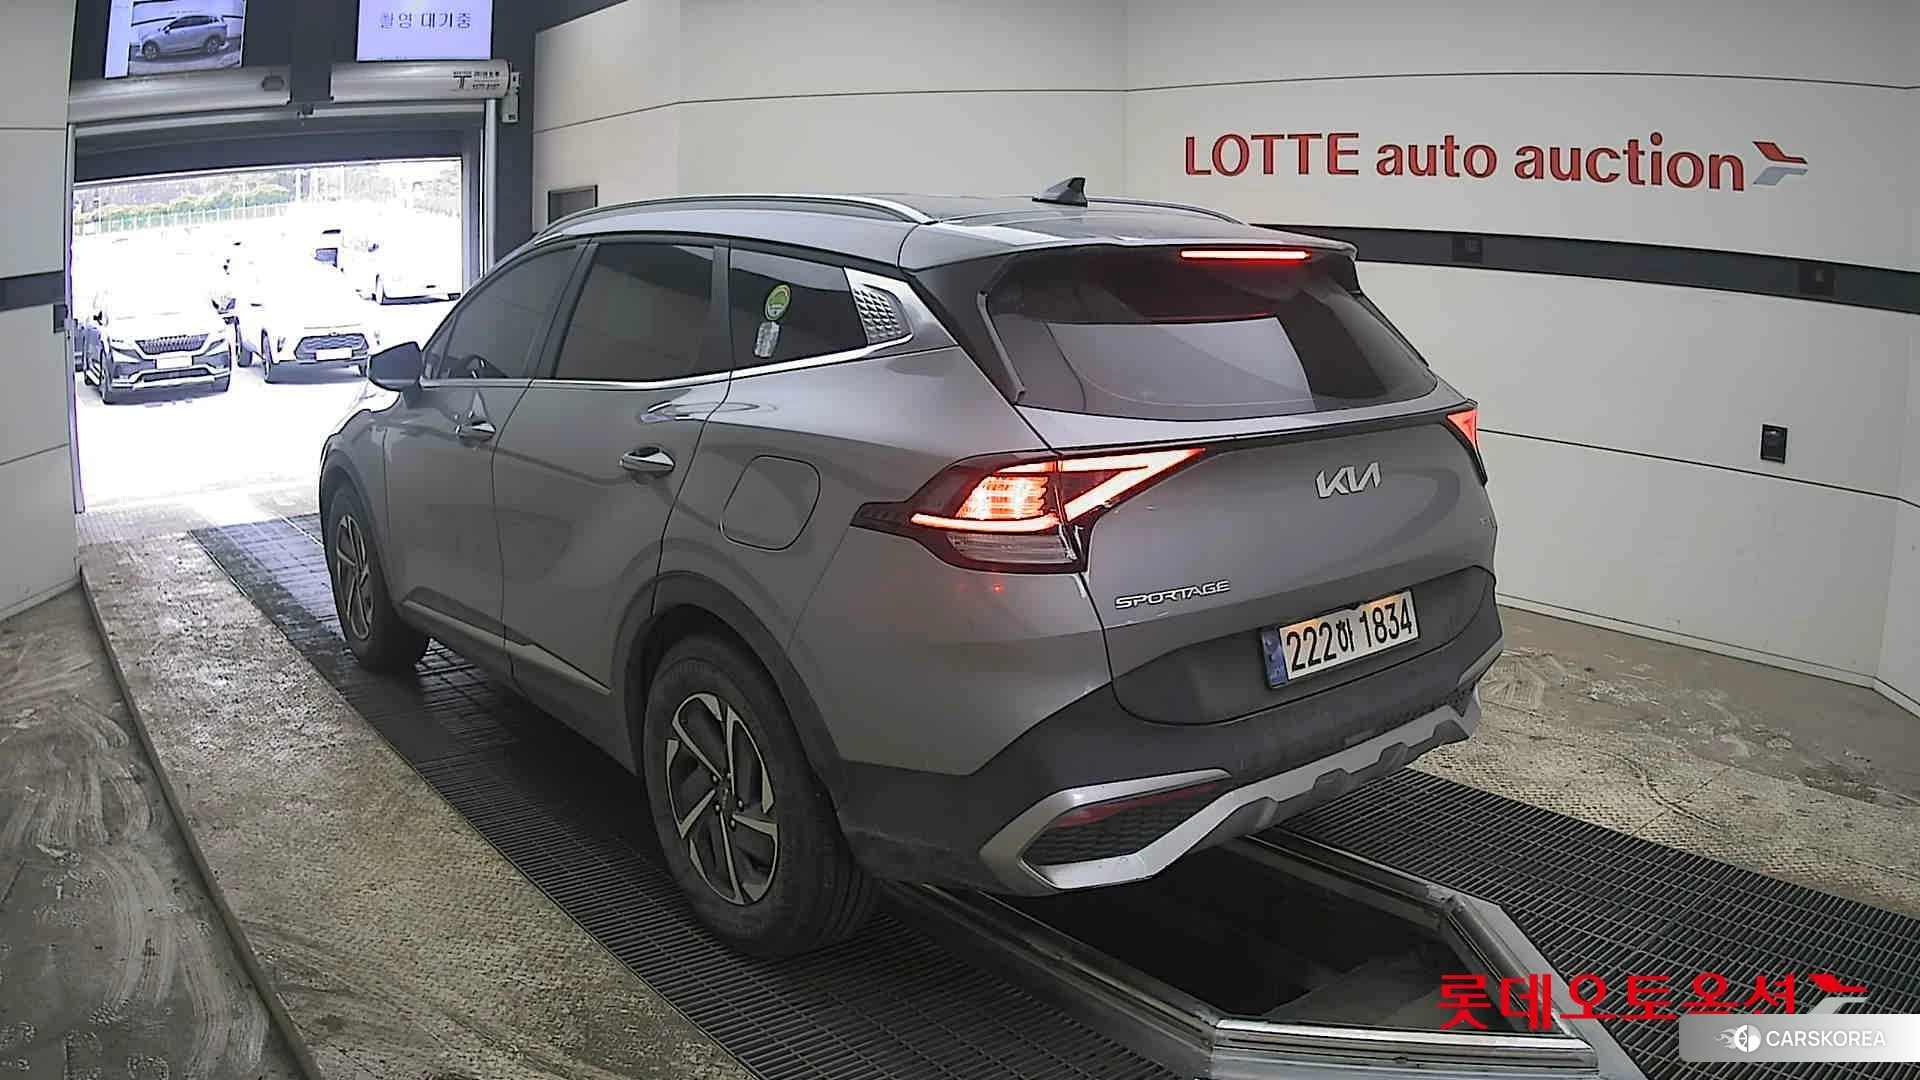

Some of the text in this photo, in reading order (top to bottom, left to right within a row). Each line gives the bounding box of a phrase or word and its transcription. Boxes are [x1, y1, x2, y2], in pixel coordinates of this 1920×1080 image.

[1185, 131, 1745, 191] LOTTE auto auction
[1315, 461, 1382, 498] KIA
[1114, 580, 1231, 609] SPORTAGE
[1286, 598, 1413, 673] 222하 1834
